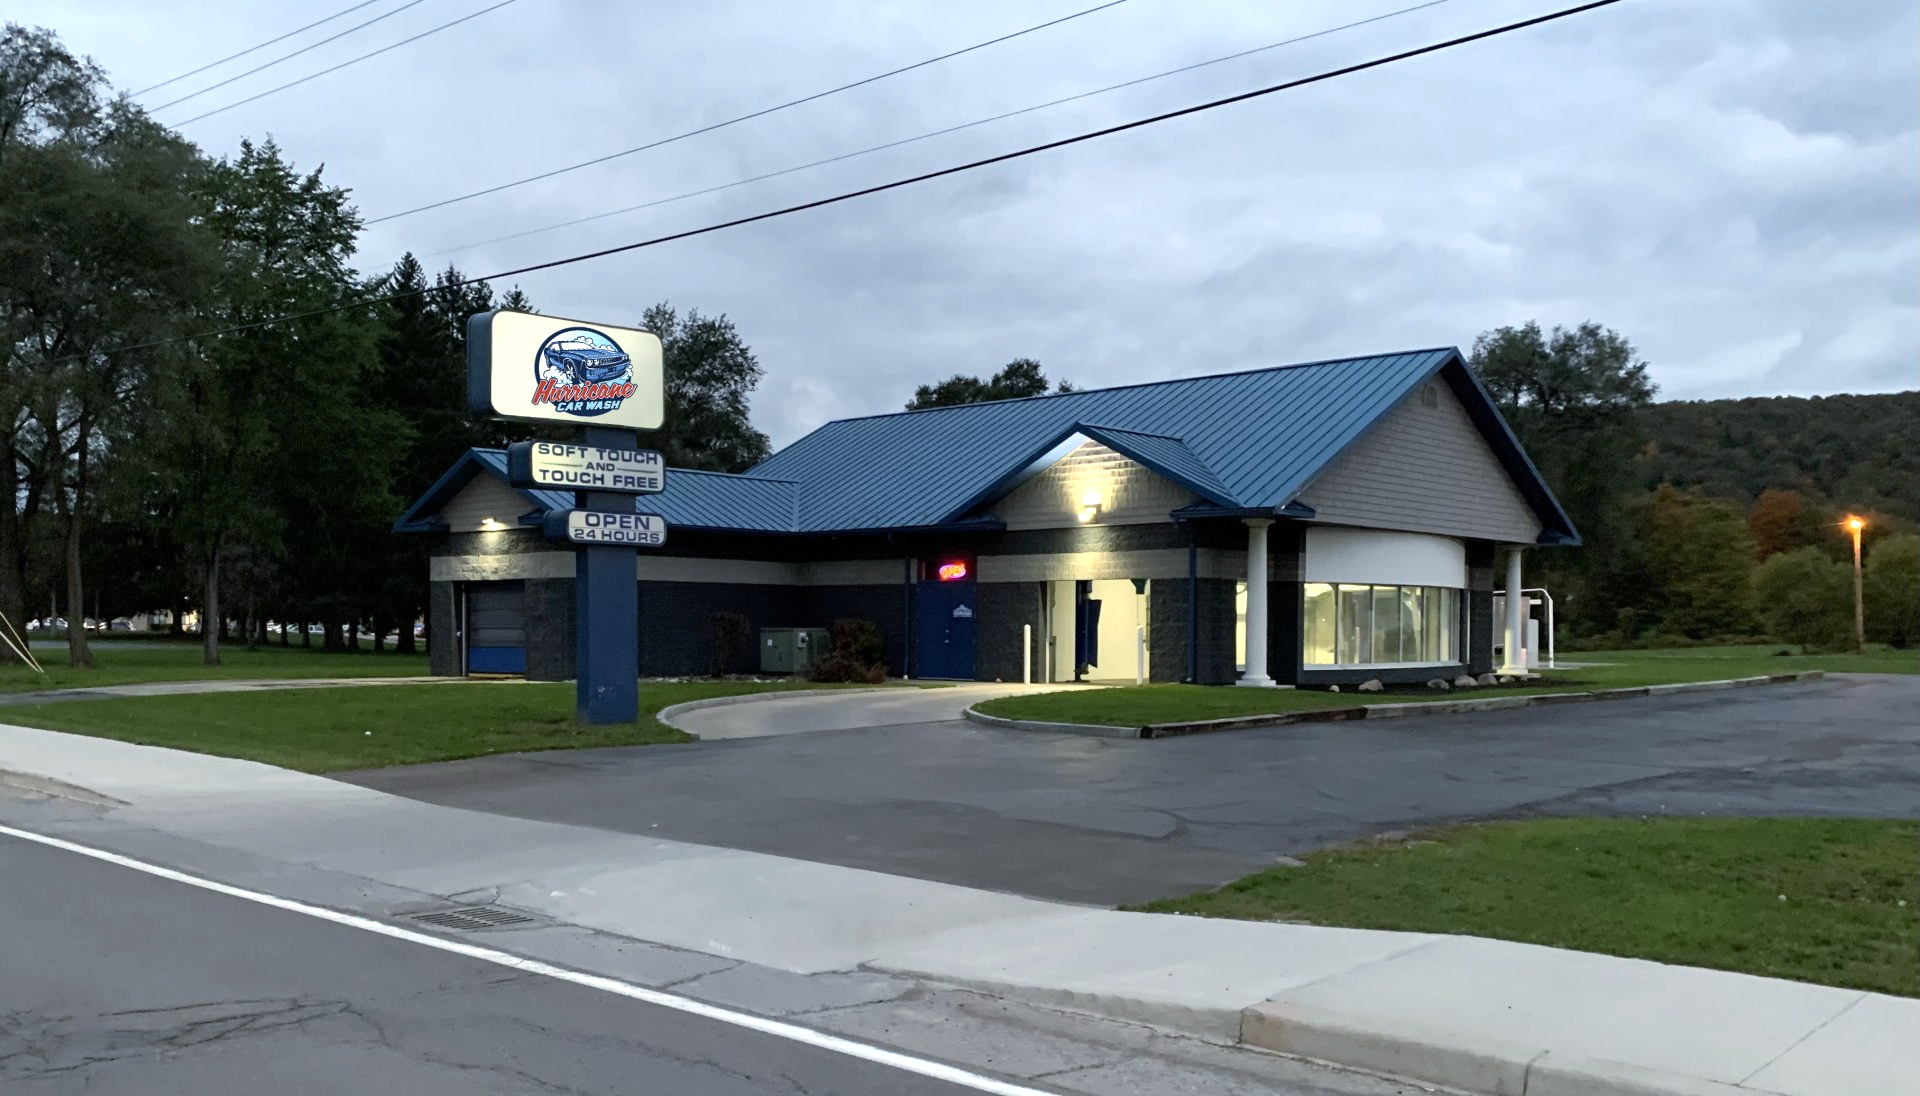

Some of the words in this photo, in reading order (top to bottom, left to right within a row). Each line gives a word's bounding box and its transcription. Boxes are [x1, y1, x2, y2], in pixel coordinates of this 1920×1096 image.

[532, 378, 637, 405] Hurricane
[557, 401, 583, 411] CAR
[586, 400, 621, 410] WASH
[538, 444, 589, 458] SOFT
[598, 449, 658, 465] TOUCH
[586, 463, 615, 472] AND
[539, 470, 604, 485] TOUCH
[614, 475, 658, 489] FREE
[585, 514, 650, 530] OPEN
[574, 529, 596, 539] 24
[601, 531, 660, 543] HOURS
[940, 563, 966, 579] OPEN
